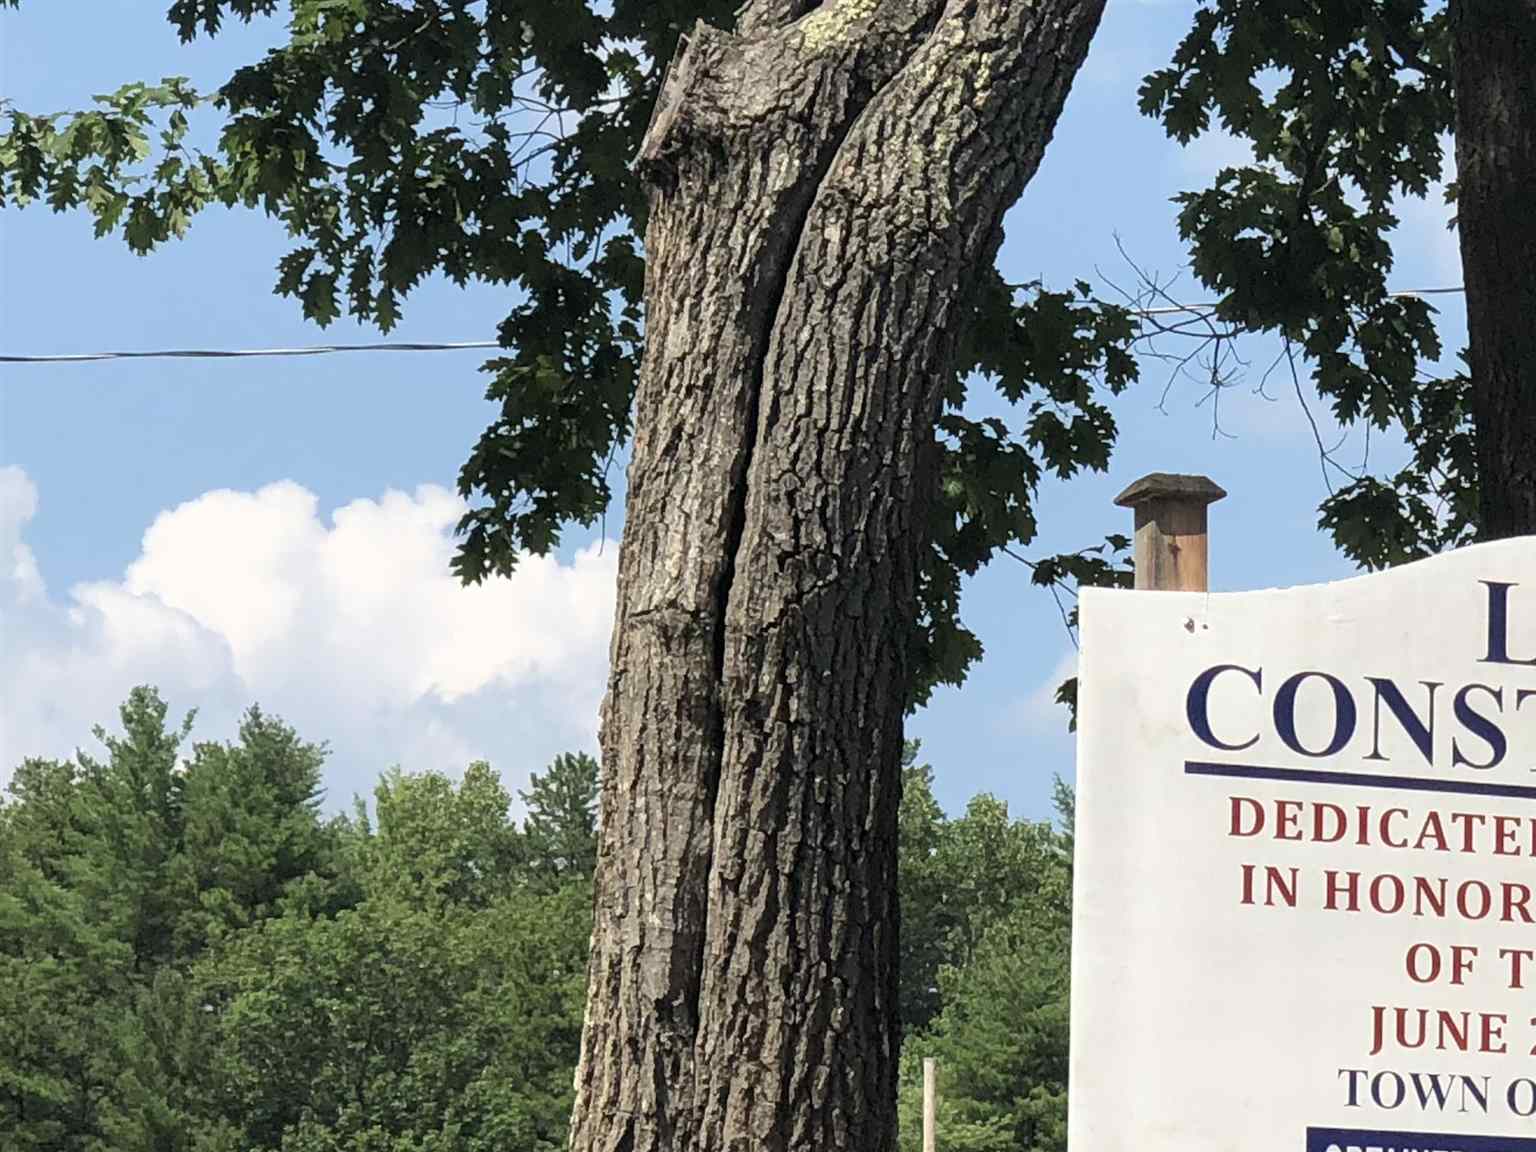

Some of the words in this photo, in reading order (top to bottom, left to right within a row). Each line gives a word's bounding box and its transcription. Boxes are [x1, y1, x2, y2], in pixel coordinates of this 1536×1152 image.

[1242, 865, 1299, 906] IN
[1324, 871, 1534, 923] HONOR
[1407, 944, 1477, 984] OF
[1370, 1007, 1506, 1055] JUNE
[1339, 1070, 1490, 1112] TOWN
